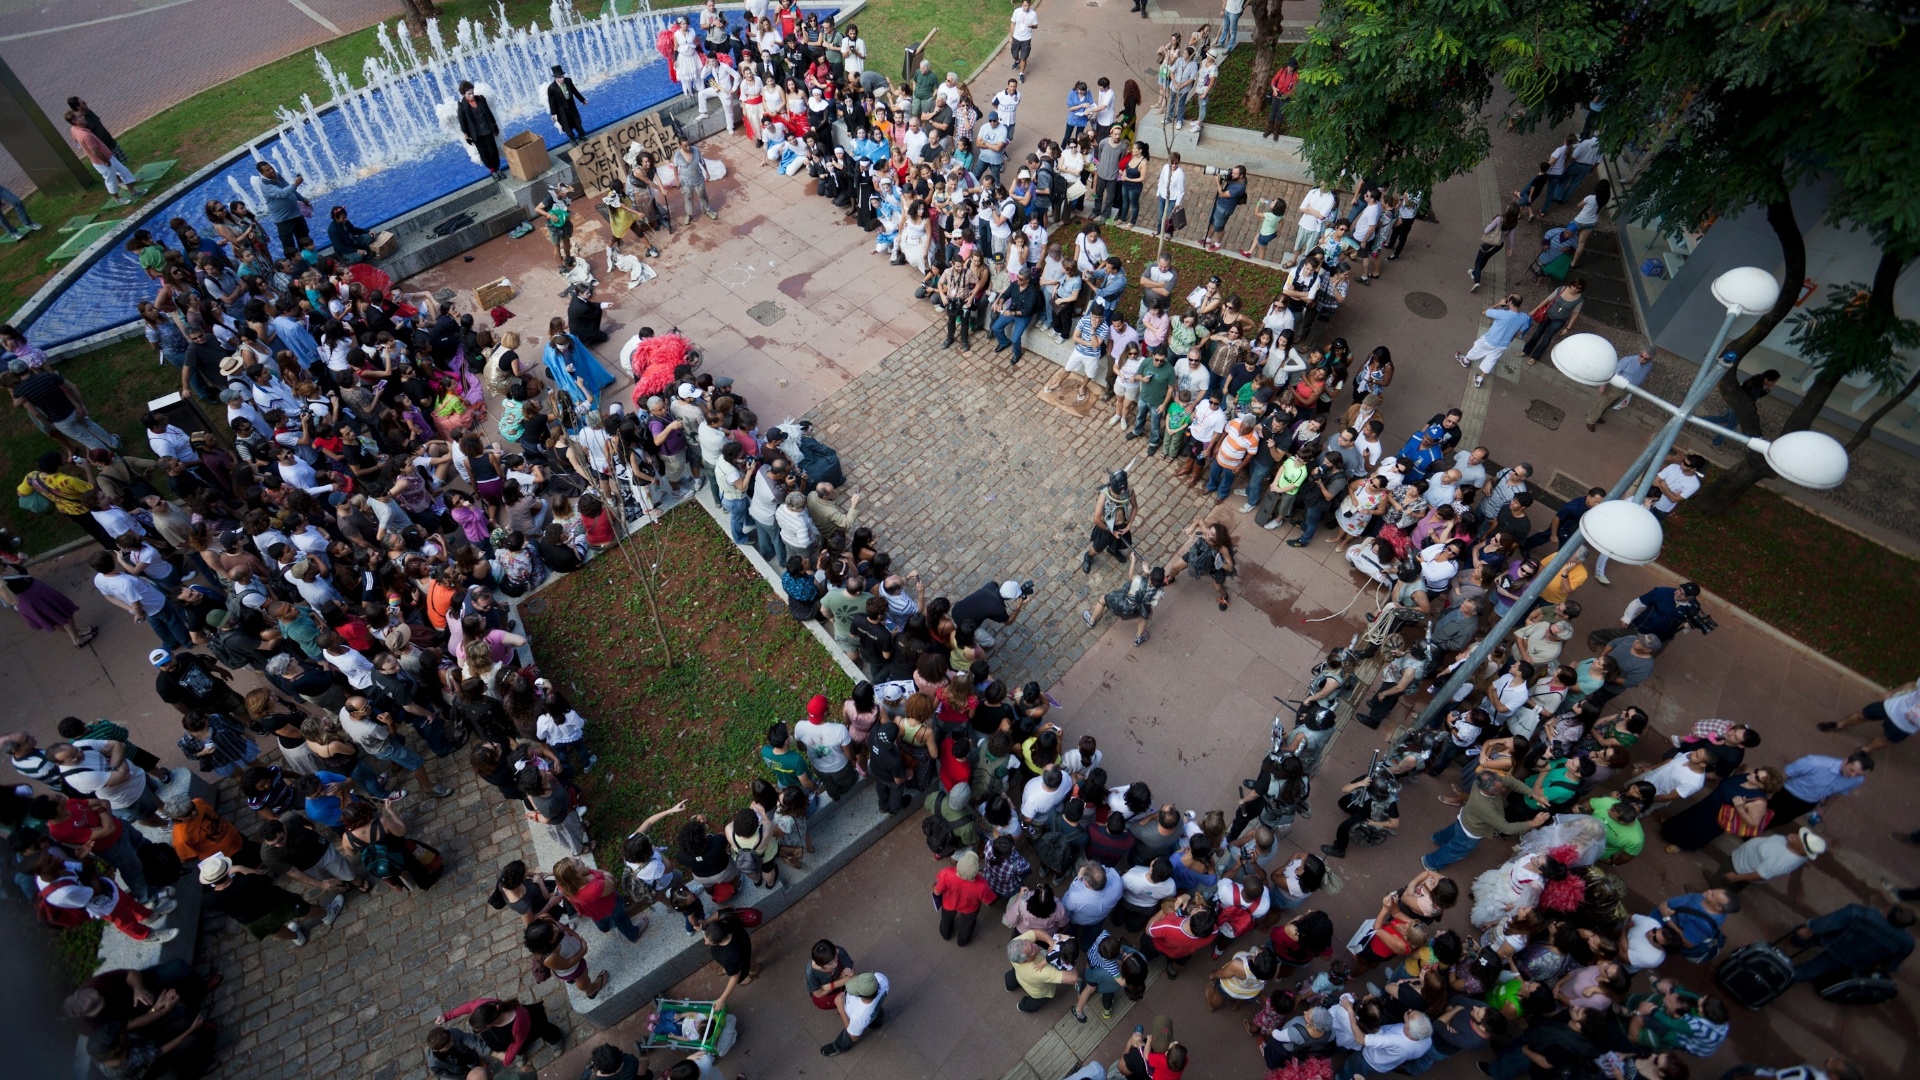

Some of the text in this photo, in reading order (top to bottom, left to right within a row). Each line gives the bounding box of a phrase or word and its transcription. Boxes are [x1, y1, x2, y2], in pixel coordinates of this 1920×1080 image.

[579, 140, 606, 166] SE
[606, 135, 619, 153] A
[617, 117, 656, 145] COPA
[588, 153, 619, 176] VEM
